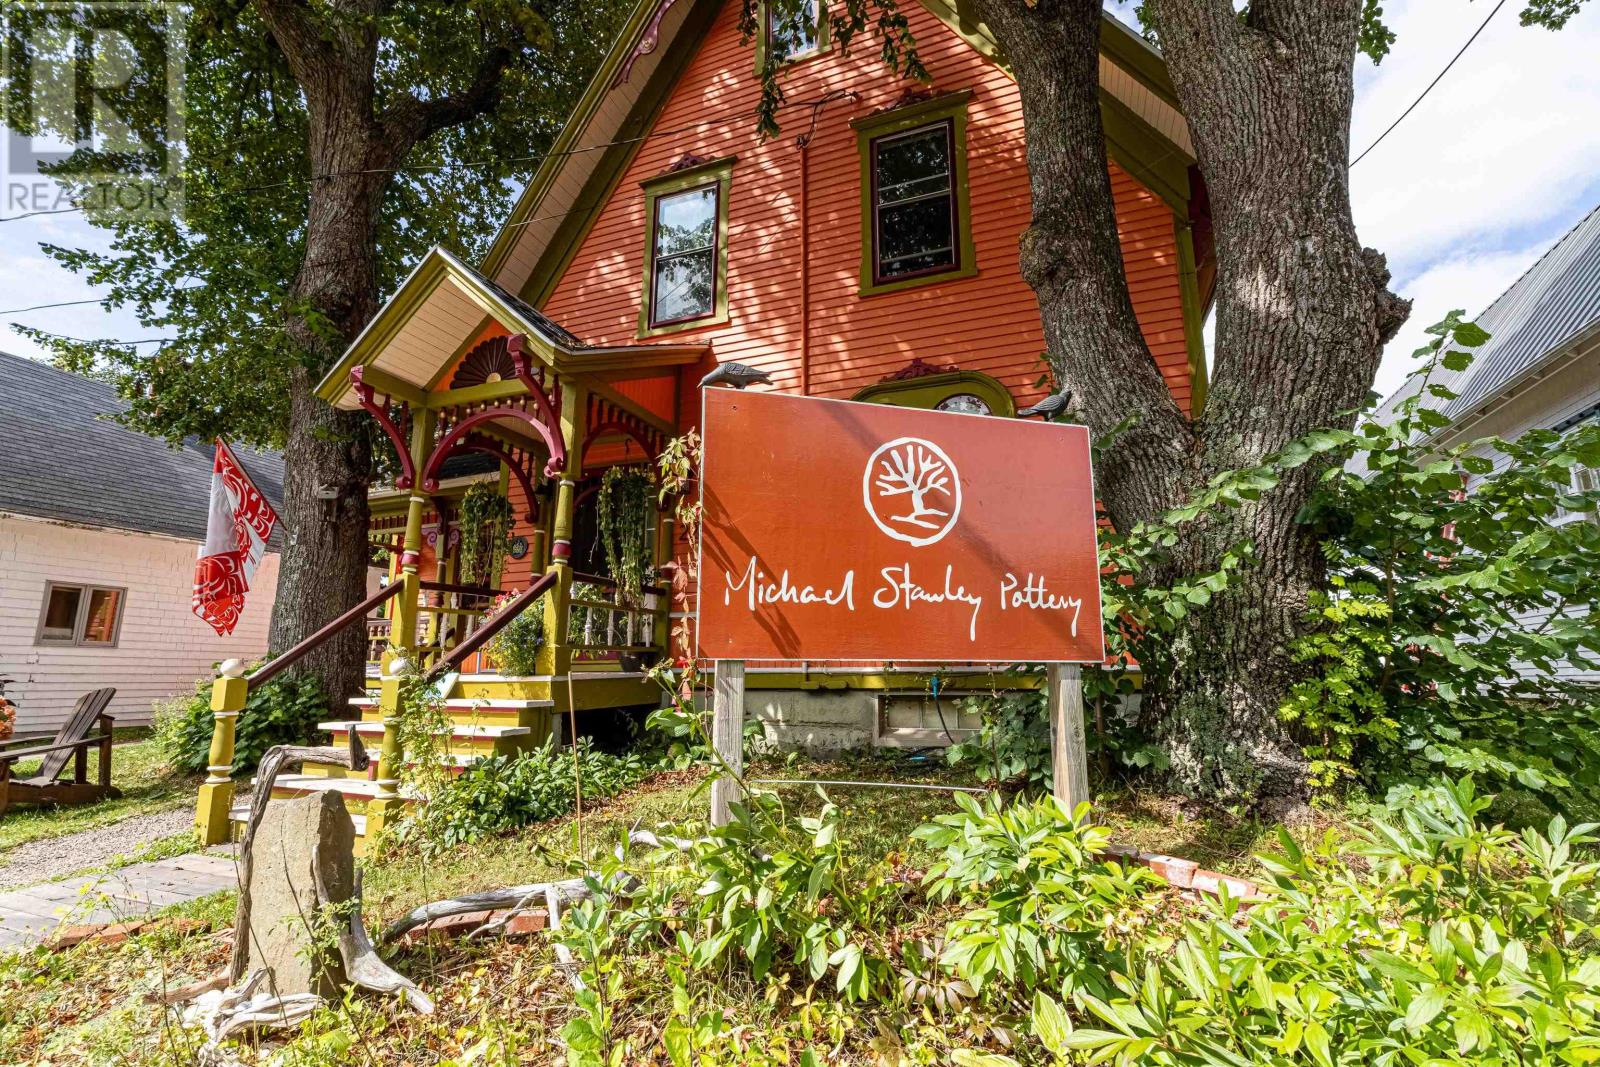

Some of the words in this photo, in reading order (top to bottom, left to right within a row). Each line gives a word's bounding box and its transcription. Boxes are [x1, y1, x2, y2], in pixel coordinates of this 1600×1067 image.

[724, 555, 854, 611] Michael
[872, 562, 982, 641] Stanley
[1000, 572, 1082, 637] Pottery
